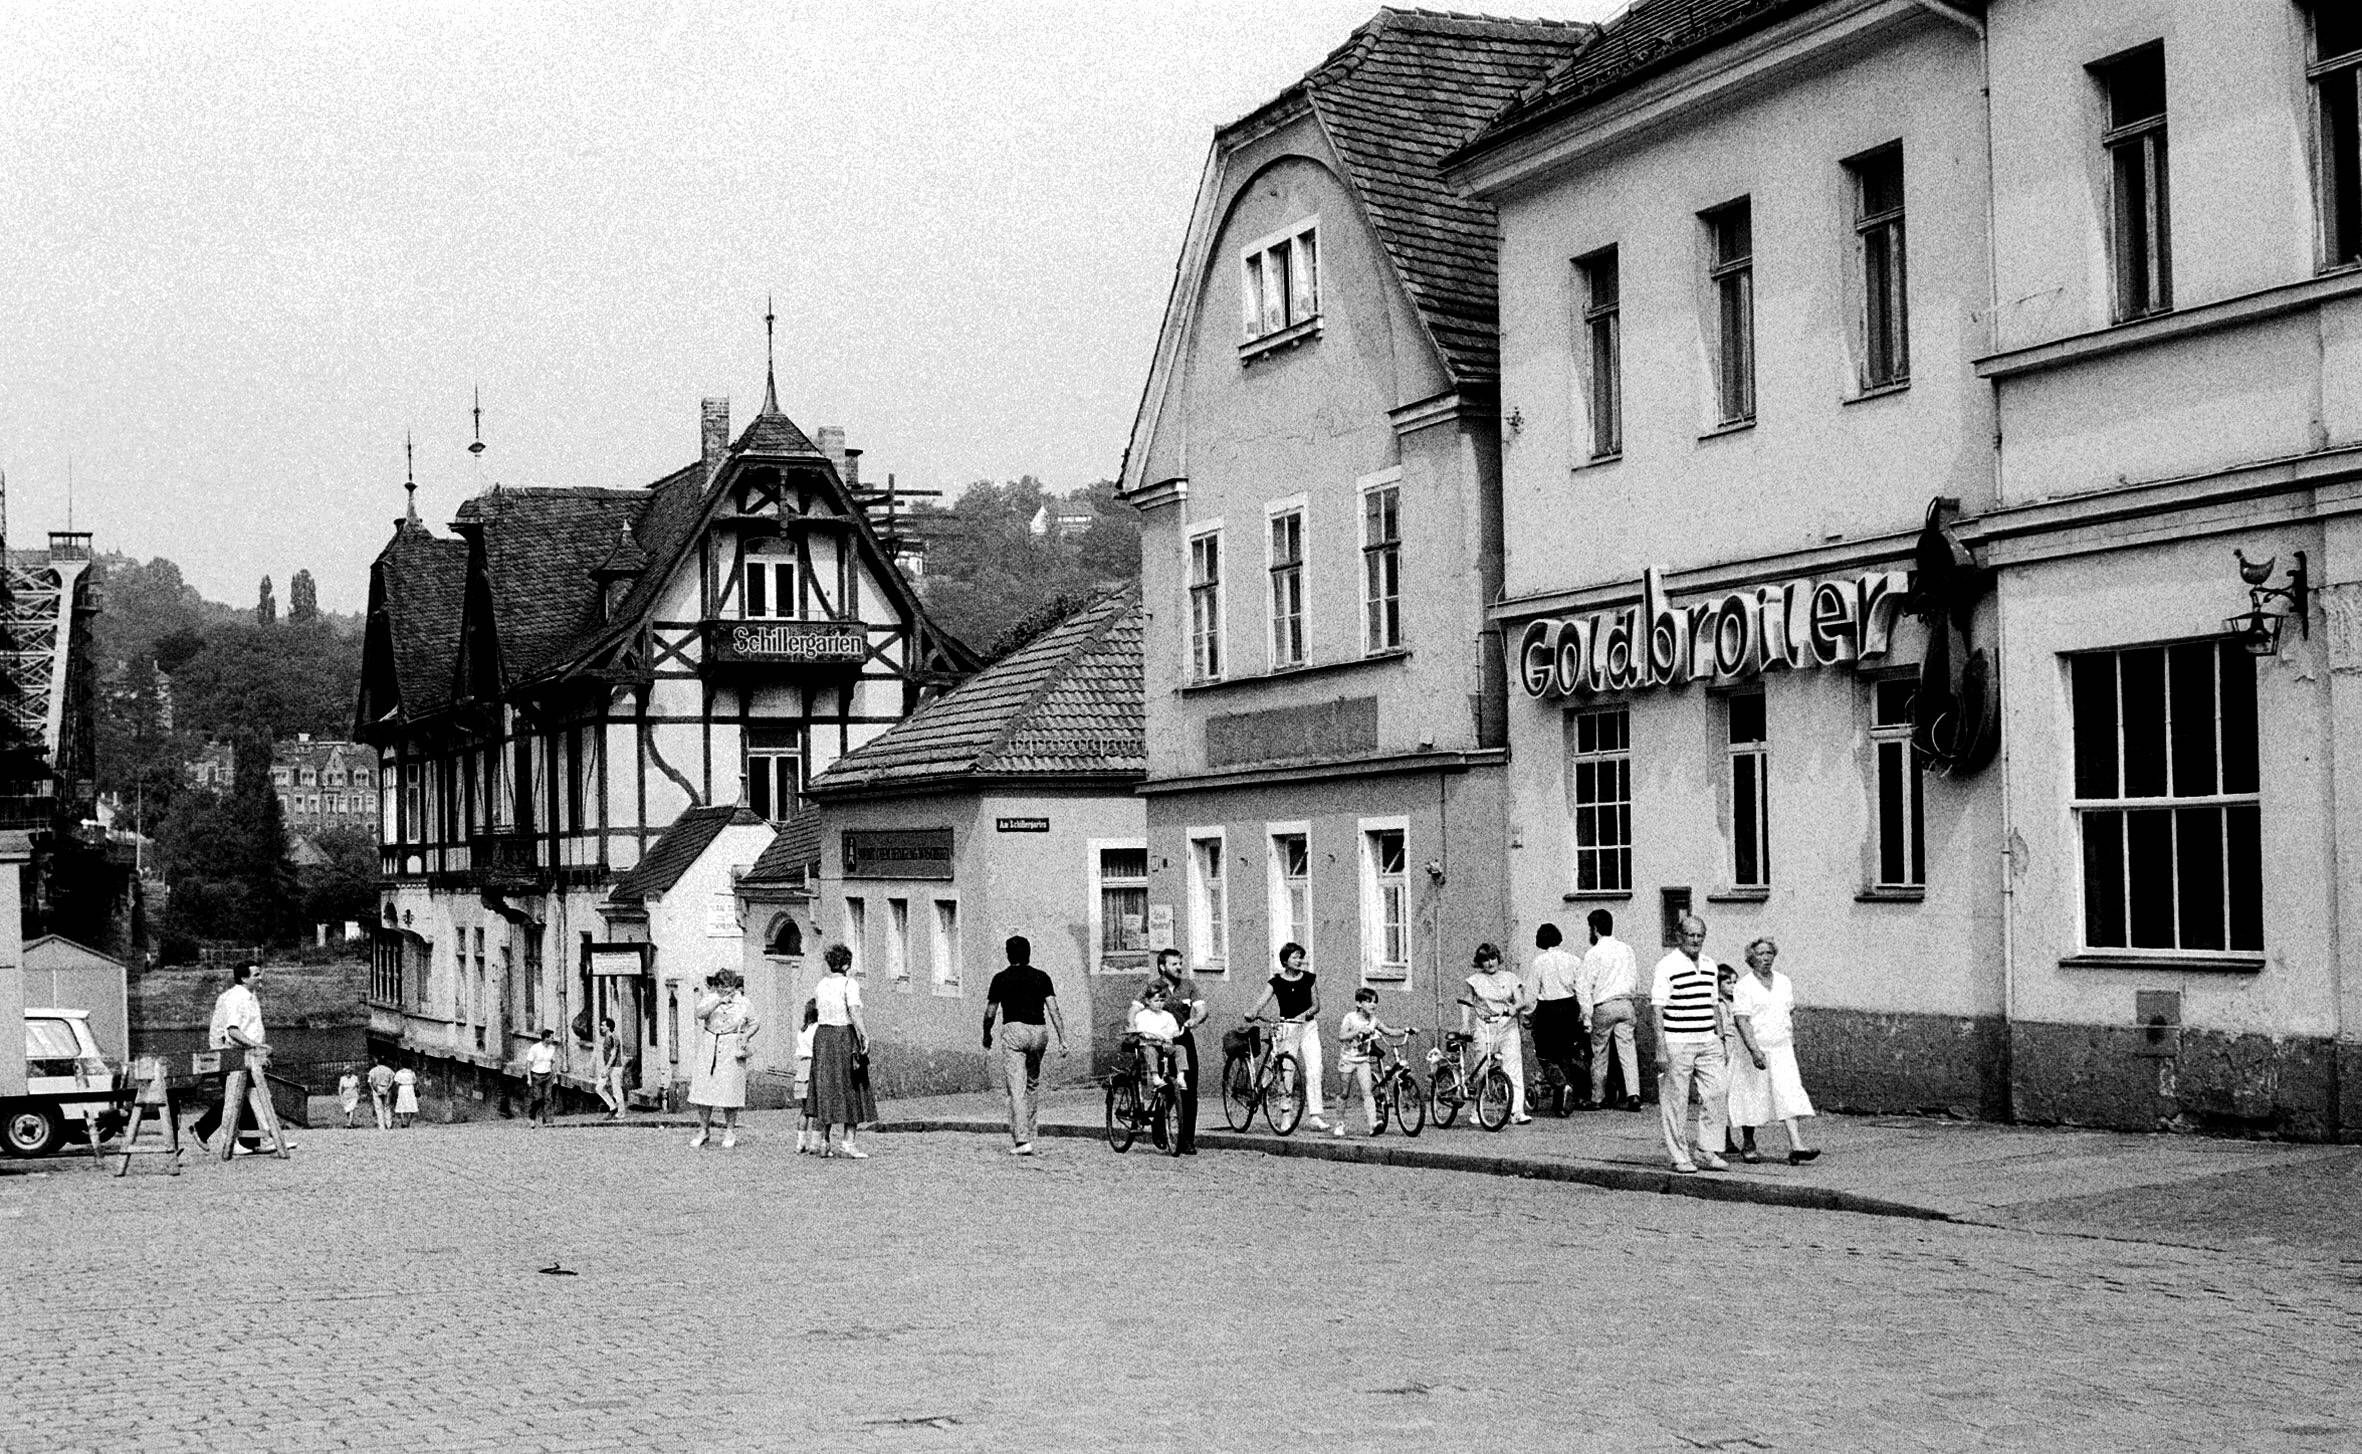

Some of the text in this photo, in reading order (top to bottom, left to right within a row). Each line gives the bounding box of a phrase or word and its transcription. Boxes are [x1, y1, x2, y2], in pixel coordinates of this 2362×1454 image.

[733, 627, 863, 658] Schillergarten
[1519, 566, 1908, 698] Goldbroiler
[999, 820, 1009, 828] Am
